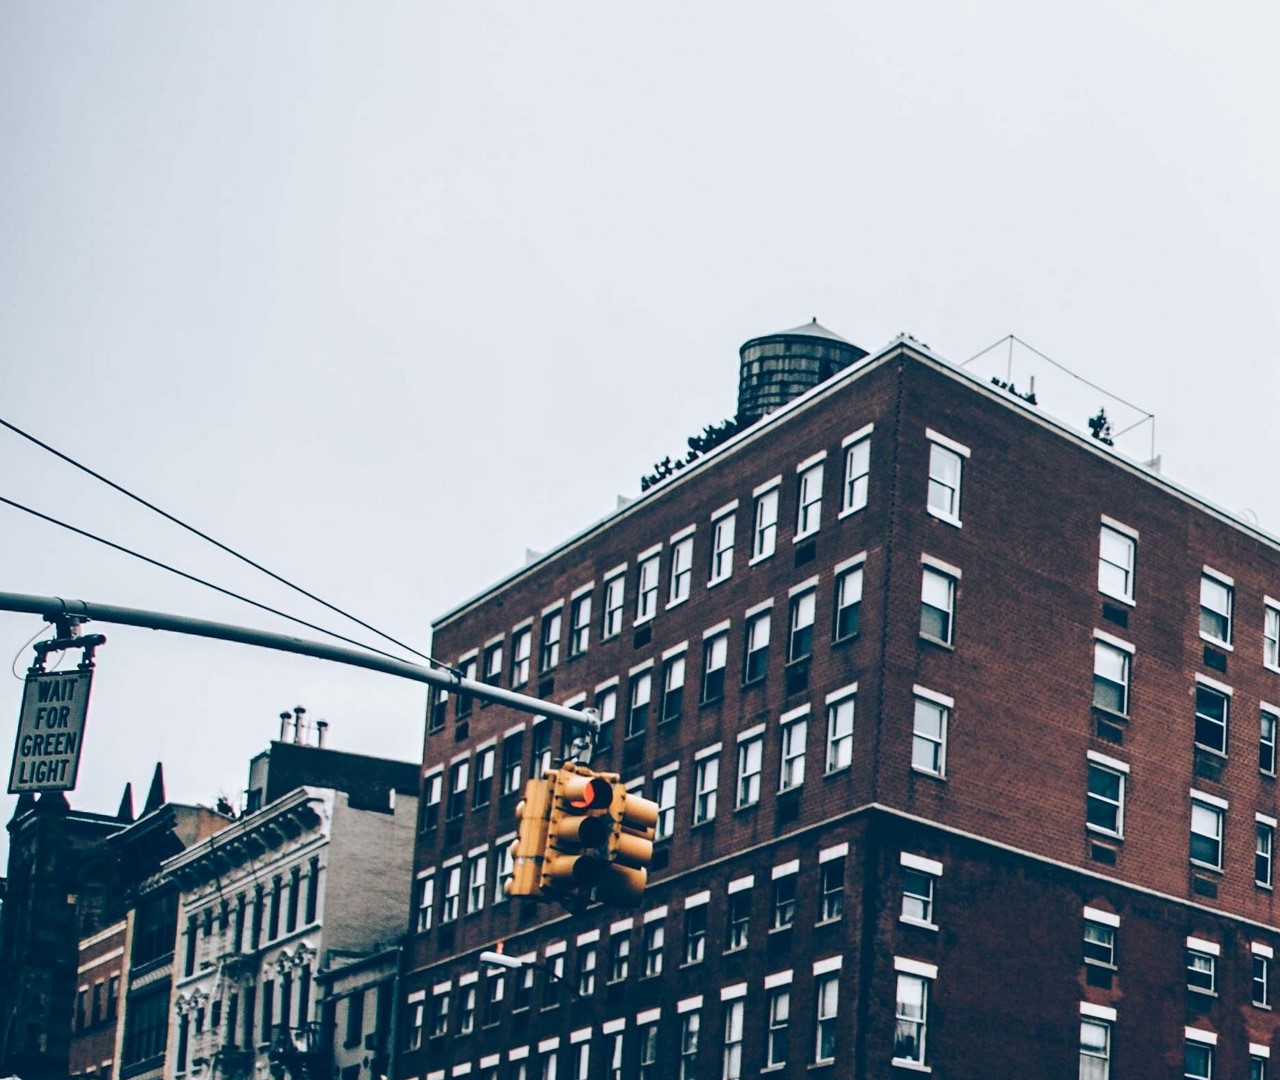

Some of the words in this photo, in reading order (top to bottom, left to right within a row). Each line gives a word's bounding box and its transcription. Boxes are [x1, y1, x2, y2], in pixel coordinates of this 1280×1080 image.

[37, 678, 78, 703] WAIT
[34, 705, 70, 730] FOR
[21, 731, 78, 758] GREEN
[18, 758, 70, 784] LIGHT
